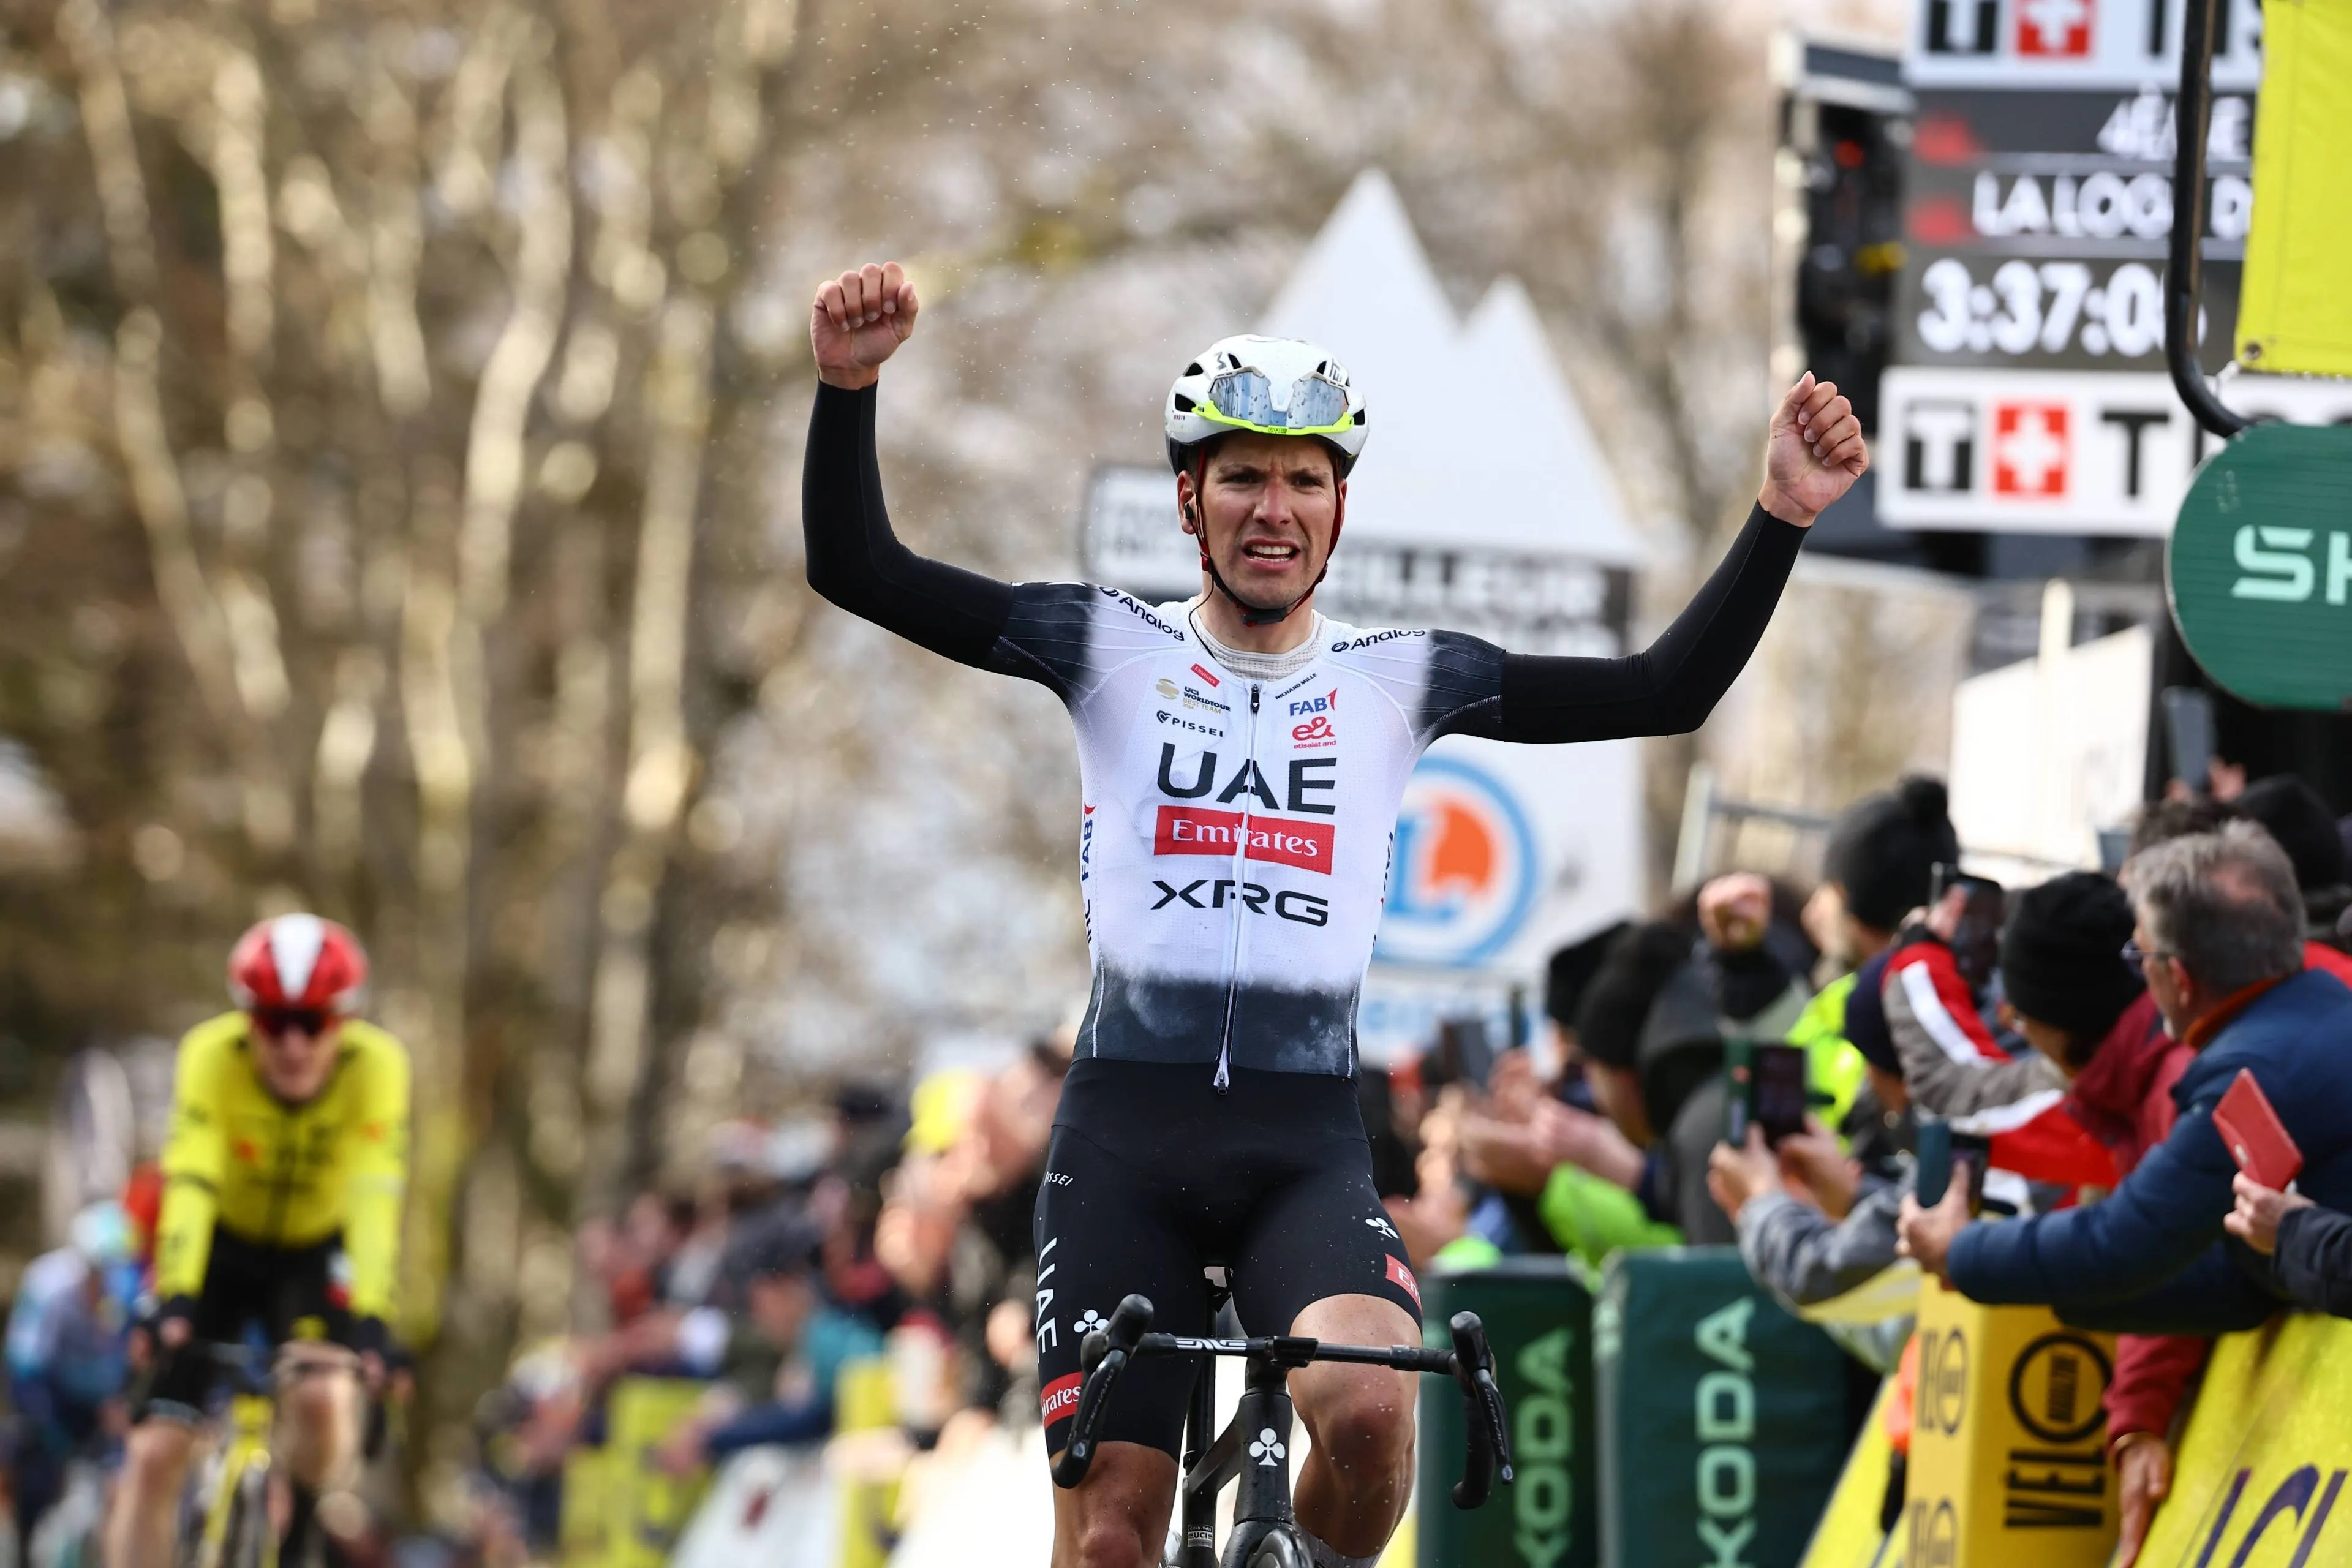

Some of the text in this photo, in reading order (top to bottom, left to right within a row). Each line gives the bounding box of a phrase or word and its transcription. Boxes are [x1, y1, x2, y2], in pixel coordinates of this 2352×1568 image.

[1972, 170, 2051, 236] LA
[1118, 597, 1185, 641] Analog
[1183, 692, 1231, 711] WORLDTOUR
[1184, 686, 1199, 696] UCI
[1275, 673, 1317, 699] RICHARD MILLE
[1183, 697, 1221, 714] BEST TEAM
[1289, 697, 1328, 717] FAB
[1172, 717, 1224, 737] PISSEI
[1157, 742, 1338, 815] UAE
[1172, 819, 1319, 857] Emirates
[1150, 880, 1329, 927] XRG
[1036, 1237, 1058, 1364] UAE
[1042, 1385, 1082, 1420] irates
[1514, 1326, 1574, 1568] KODA
[1695, 1296, 1757, 1568] KODA
